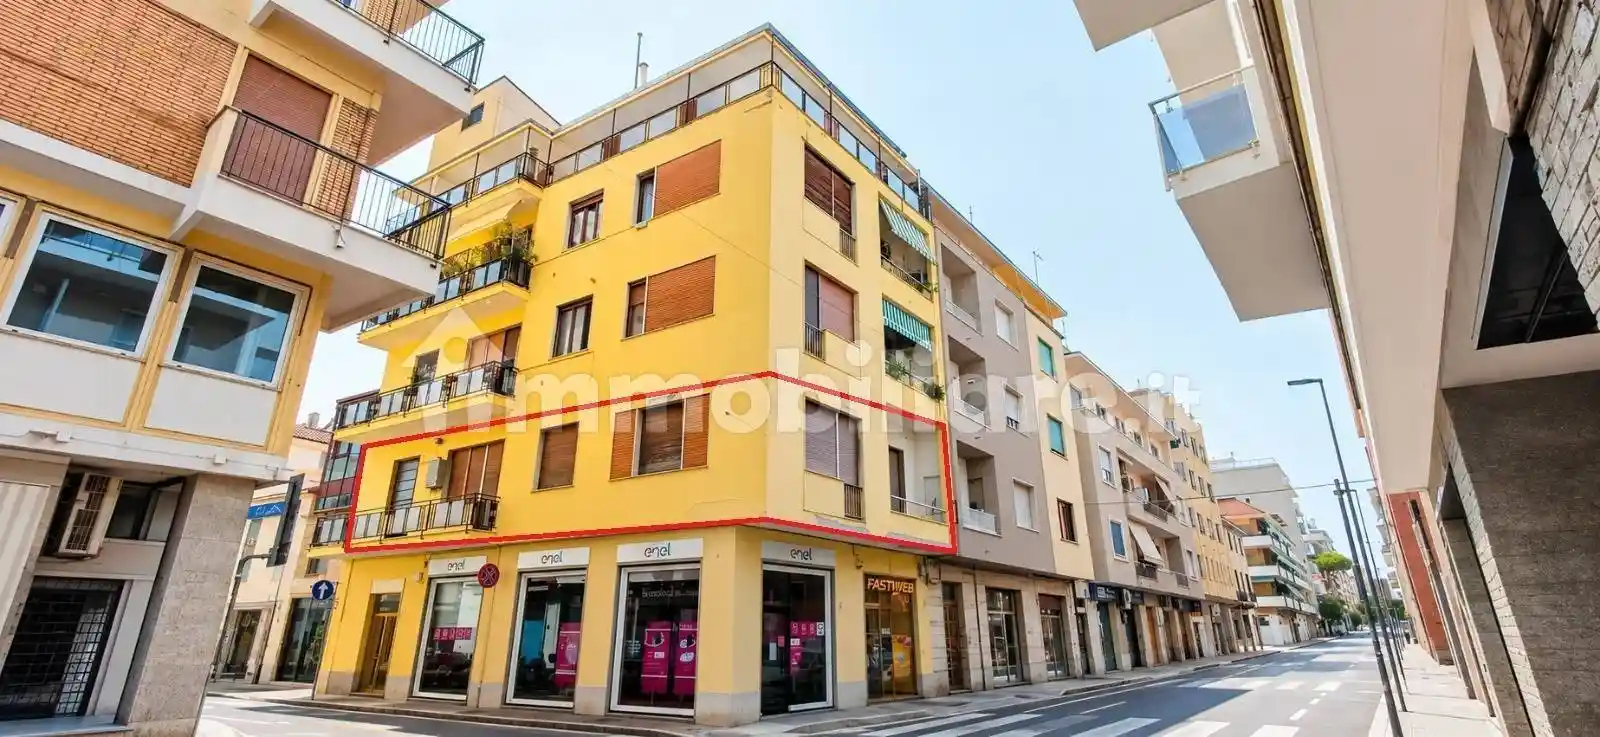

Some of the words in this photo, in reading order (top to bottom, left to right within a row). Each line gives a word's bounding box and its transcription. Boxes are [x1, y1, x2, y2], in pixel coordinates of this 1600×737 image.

[643, 542, 672, 558] enel
[789, 547, 813, 560] enel
[541, 551, 563, 565] enel
[447, 559, 465, 571] enel
